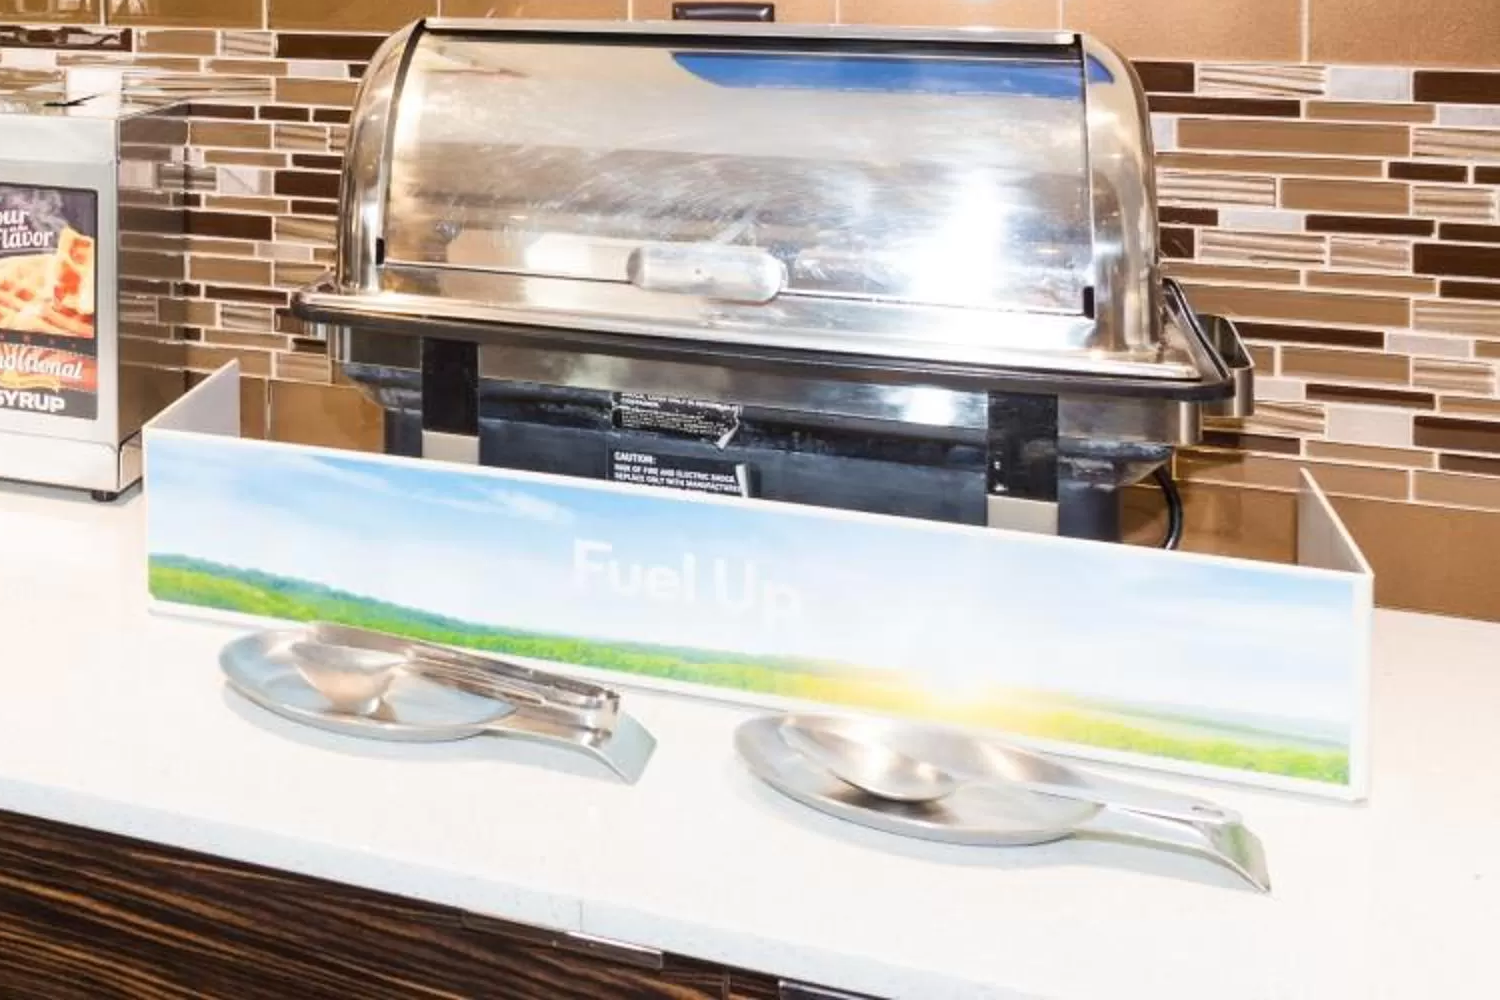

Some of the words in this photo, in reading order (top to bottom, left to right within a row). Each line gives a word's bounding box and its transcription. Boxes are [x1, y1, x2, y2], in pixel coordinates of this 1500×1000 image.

[613, 451, 657, 464] CAUTION:
[573, 536, 696, 605] Fuel
[713, 556, 804, 632] Up
